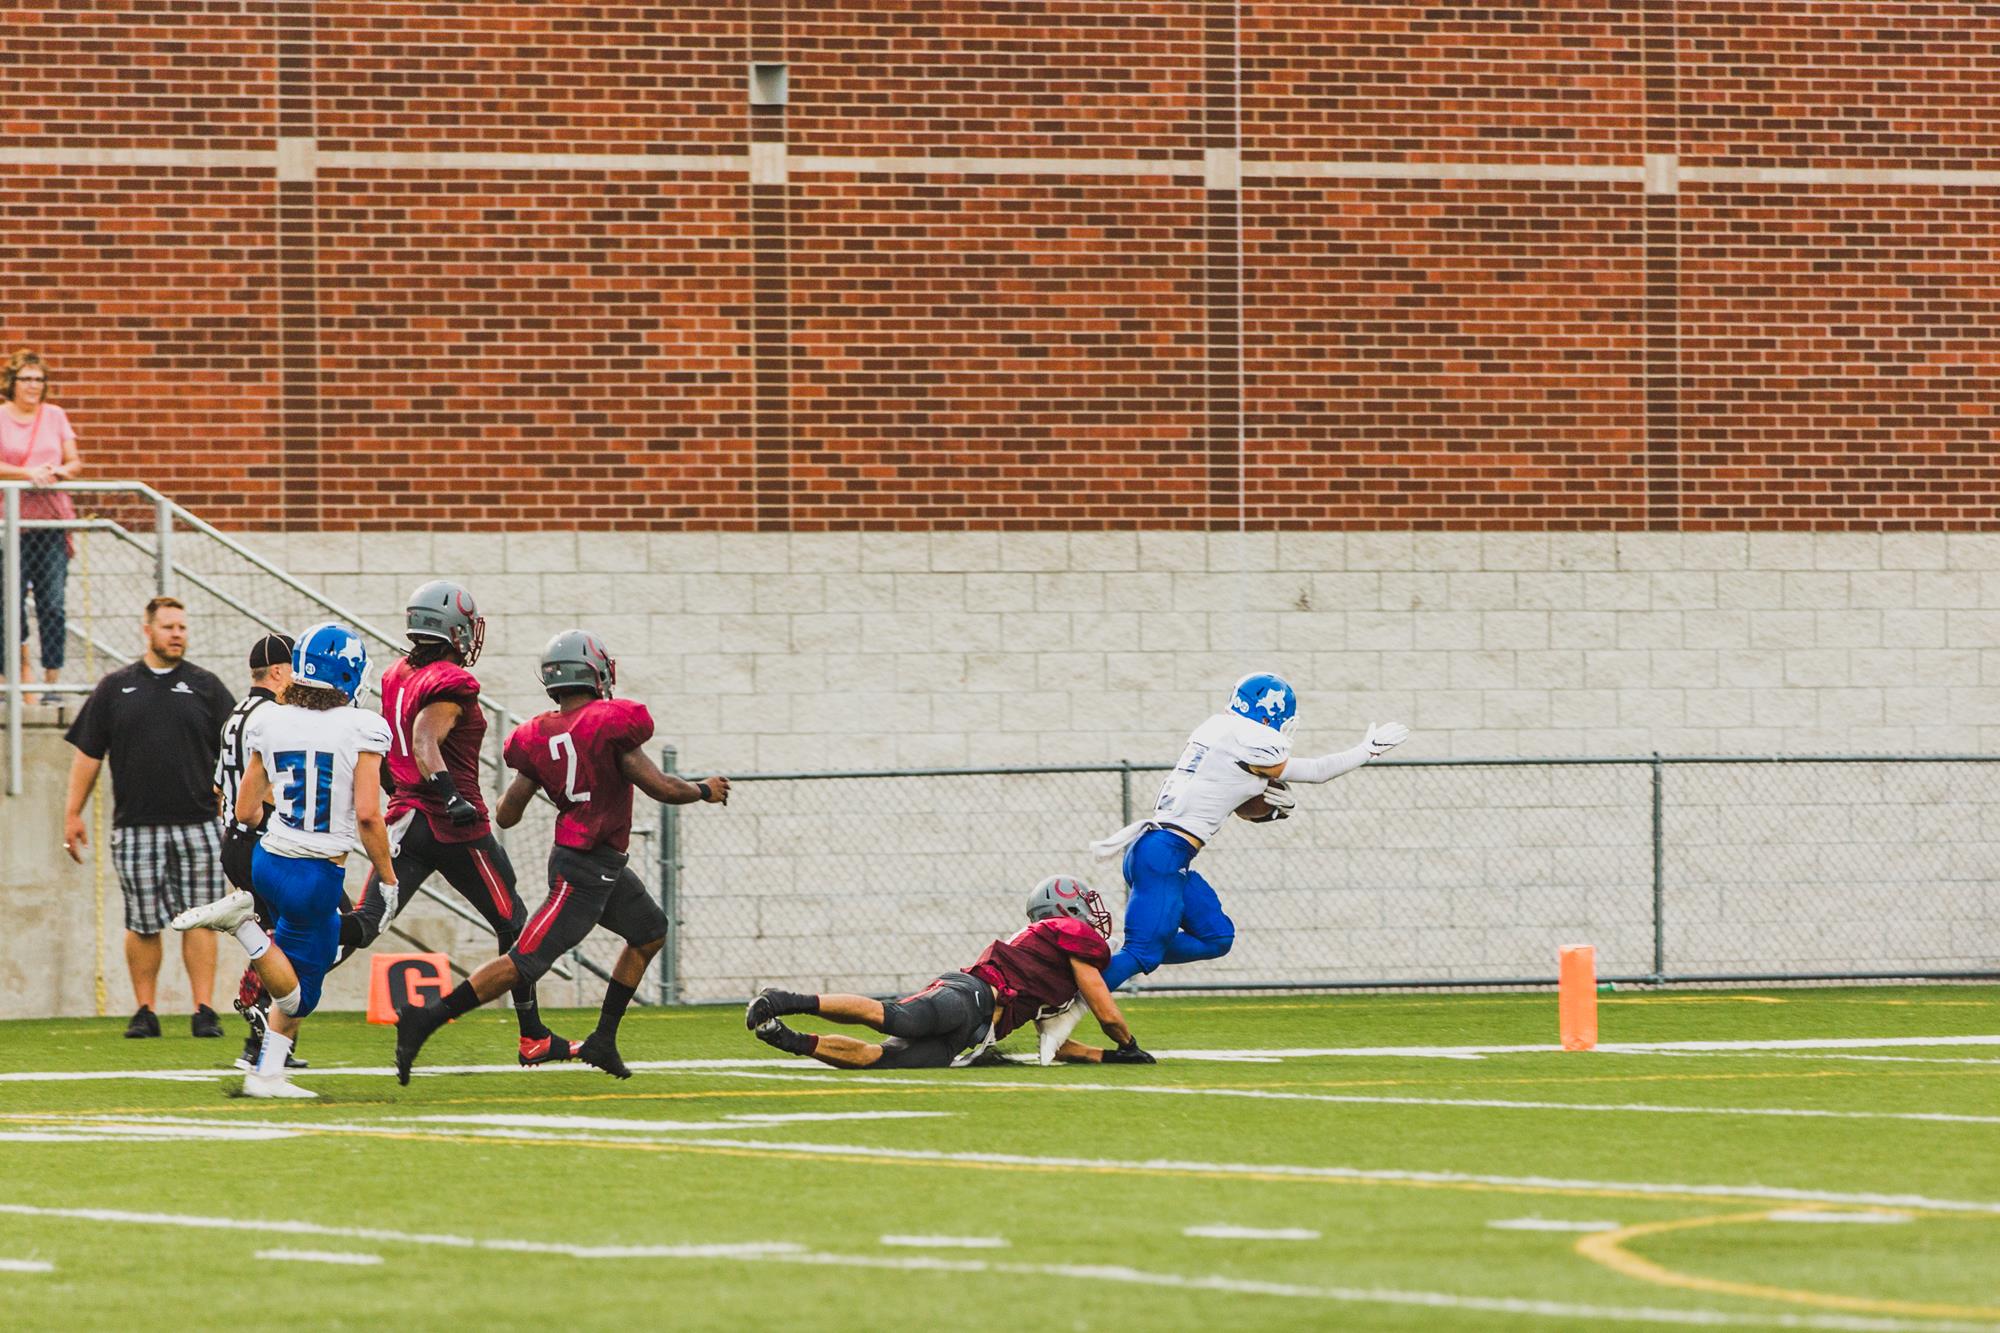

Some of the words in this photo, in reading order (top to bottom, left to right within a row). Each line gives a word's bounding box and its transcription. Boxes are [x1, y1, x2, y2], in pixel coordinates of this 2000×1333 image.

[273, 750, 334, 833] 31
[548, 732, 591, 803] 2
[387, 959, 442, 1010] G
